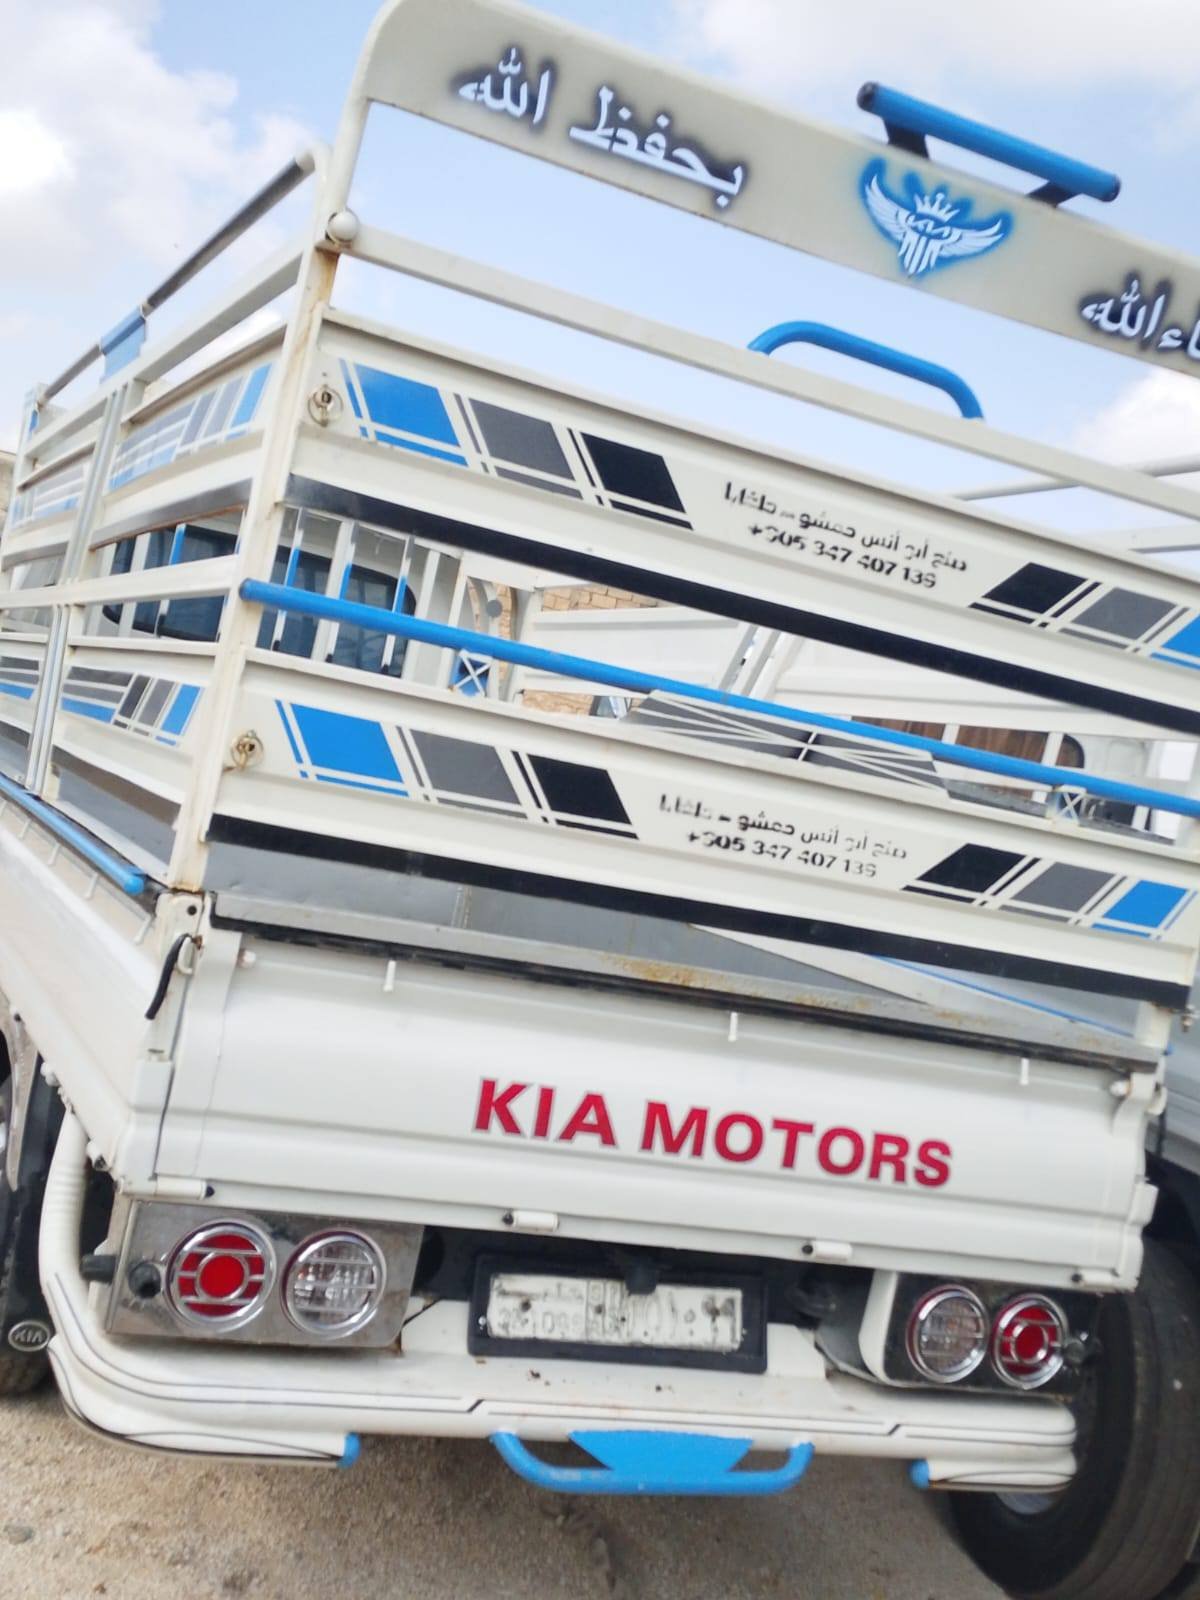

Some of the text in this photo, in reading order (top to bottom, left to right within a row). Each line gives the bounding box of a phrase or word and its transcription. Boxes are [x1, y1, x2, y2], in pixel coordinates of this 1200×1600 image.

[458, 46, 744, 208] بحفظ الله
[1081, 278, 1166, 340] الله
[474, 1077, 953, 1188] KIA MOTORS
[14, 1327, 44, 1343] KIA
